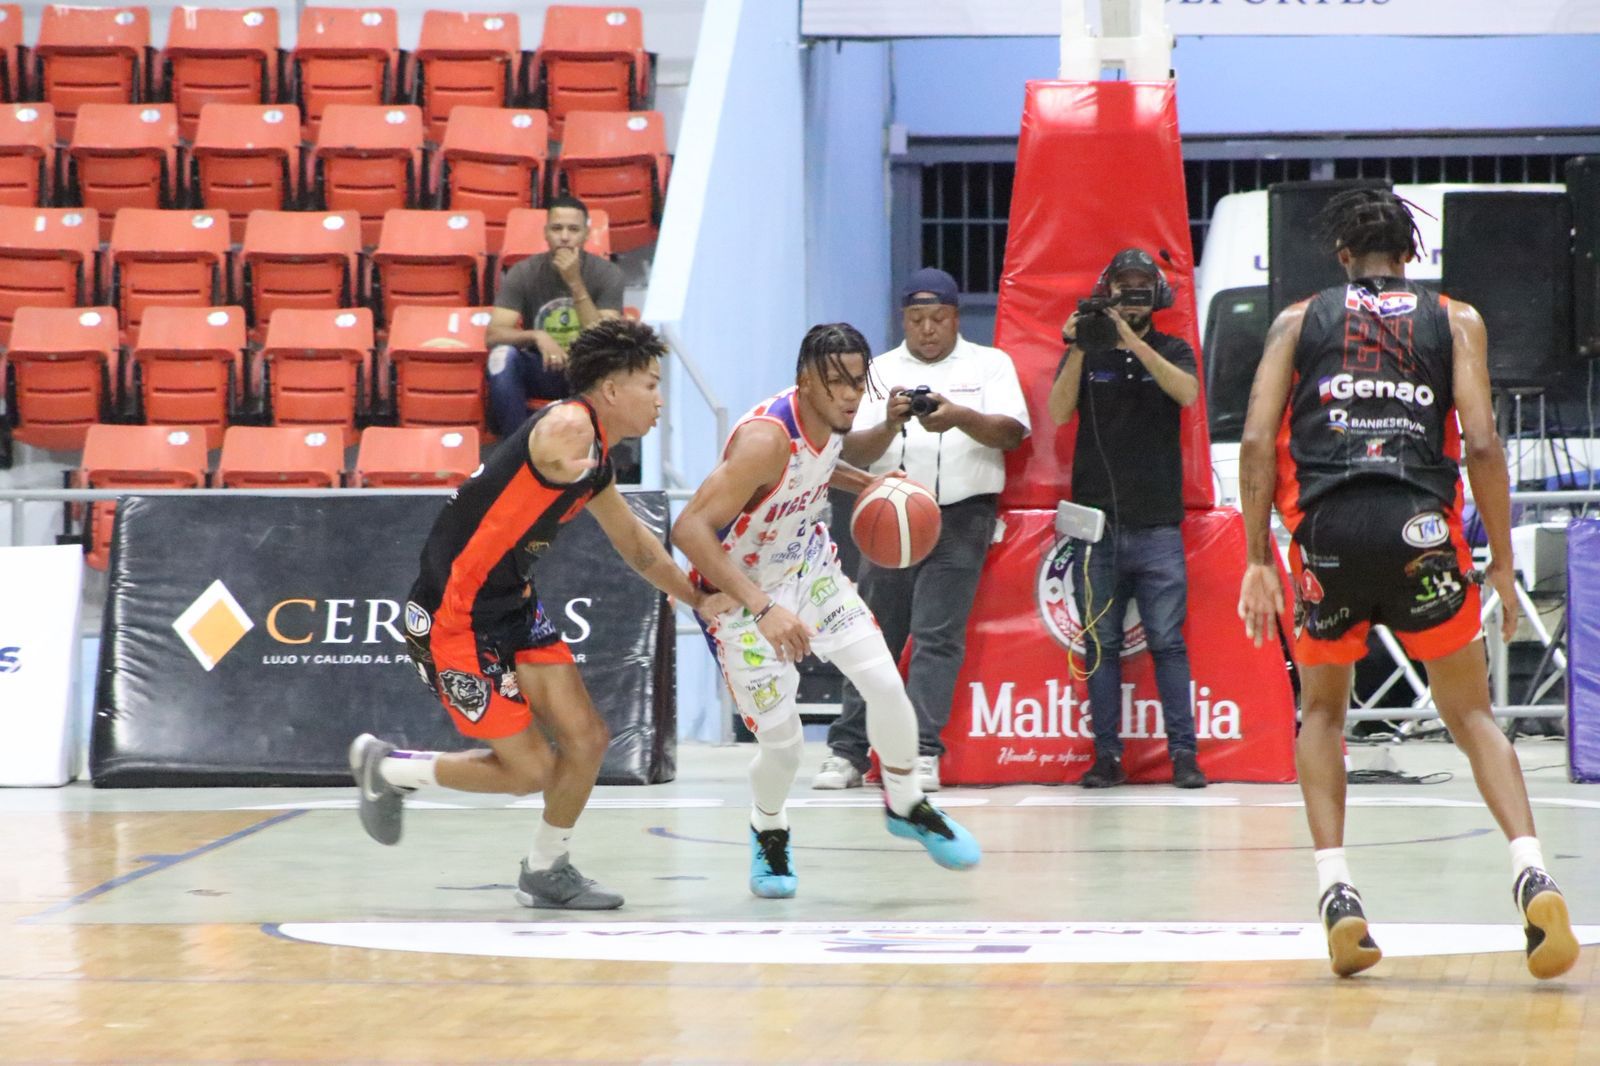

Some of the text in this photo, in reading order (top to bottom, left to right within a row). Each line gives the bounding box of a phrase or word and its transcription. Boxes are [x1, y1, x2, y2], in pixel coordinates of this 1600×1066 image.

[1329, 373, 1435, 407] Genao
[262, 655, 298, 664] LUJO
[301, 655, 311, 664] Y
[313, 654, 372, 664] CALIDAD
[374, 654, 391, 664] AL
[968, 679, 1242, 739] Malta Inia
